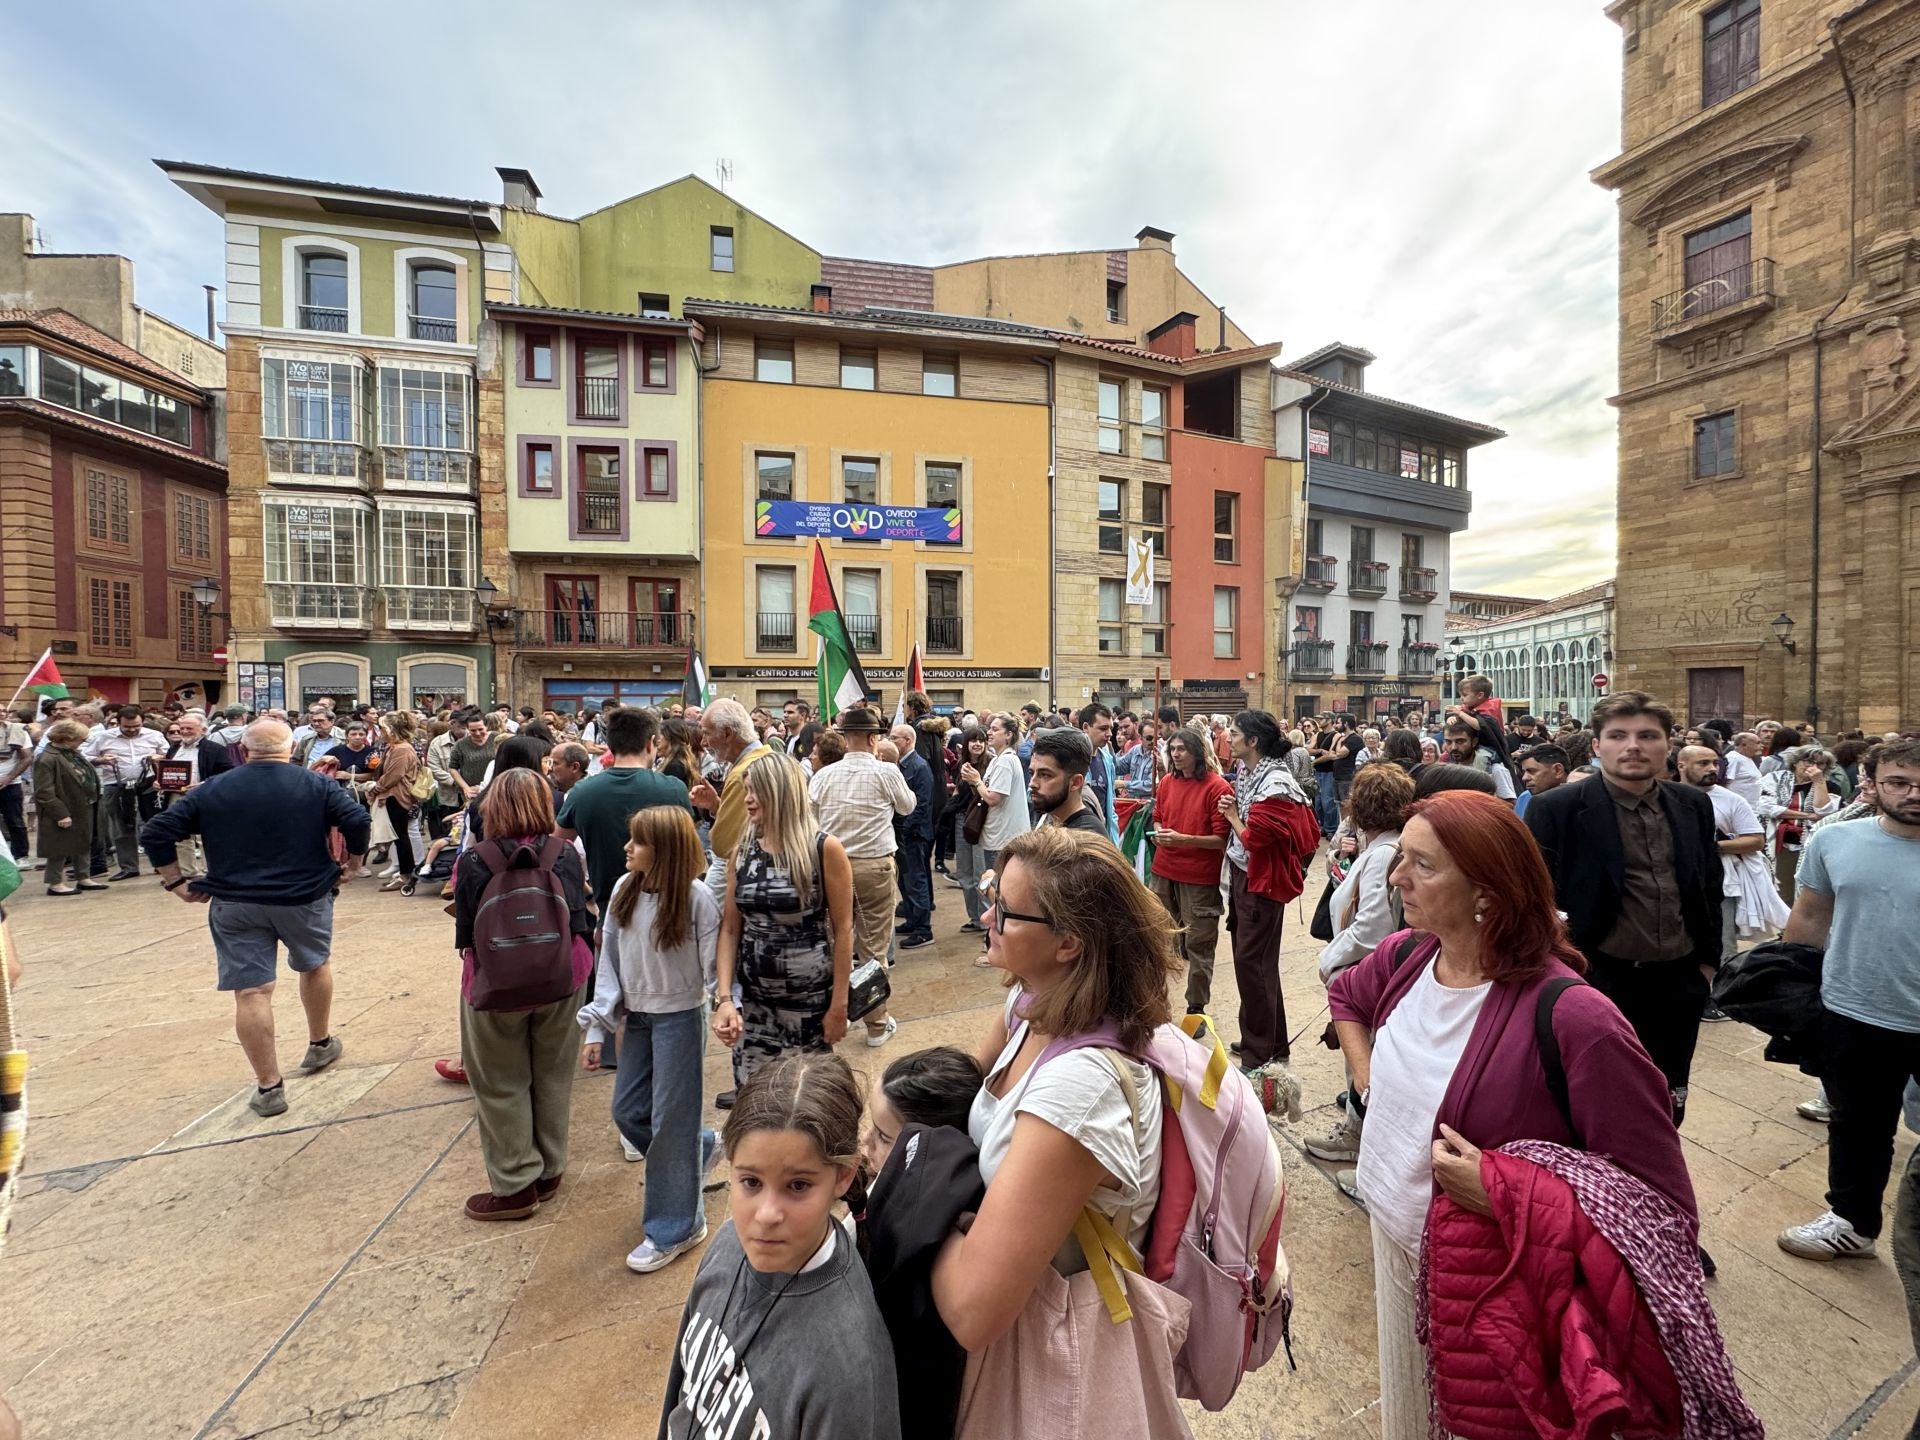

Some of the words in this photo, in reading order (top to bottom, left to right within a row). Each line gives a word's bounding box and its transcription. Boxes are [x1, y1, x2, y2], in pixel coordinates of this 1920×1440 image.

[885, 509, 918, 518] OVIEDO
[886, 519, 905, 527] VIVE
[906, 520, 915, 528] EL
[886, 528, 926, 537] DEPORTE
[756, 669, 787, 677] CENTRO
[789, 669, 799, 677] DE
